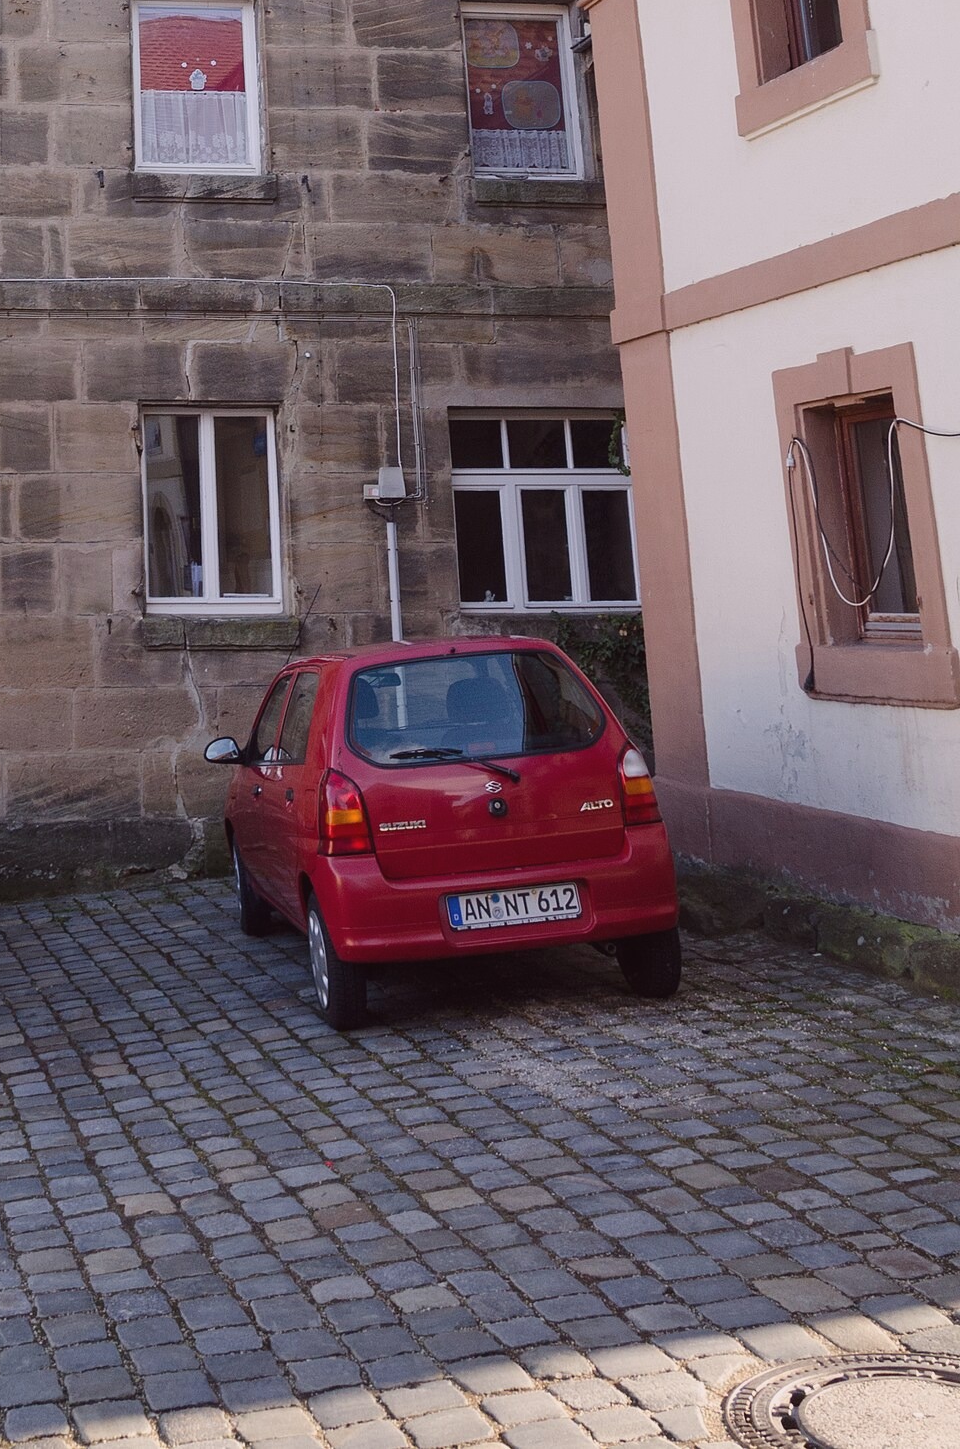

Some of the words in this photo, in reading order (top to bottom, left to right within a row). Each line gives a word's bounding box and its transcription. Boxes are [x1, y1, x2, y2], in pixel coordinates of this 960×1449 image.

[580, 799, 614, 812] ALTO
[379, 819, 426, 831] SUZUKI
[465, 896, 492, 921] AN
[503, 892, 530, 917] NT
[537, 887, 578, 913] 612
